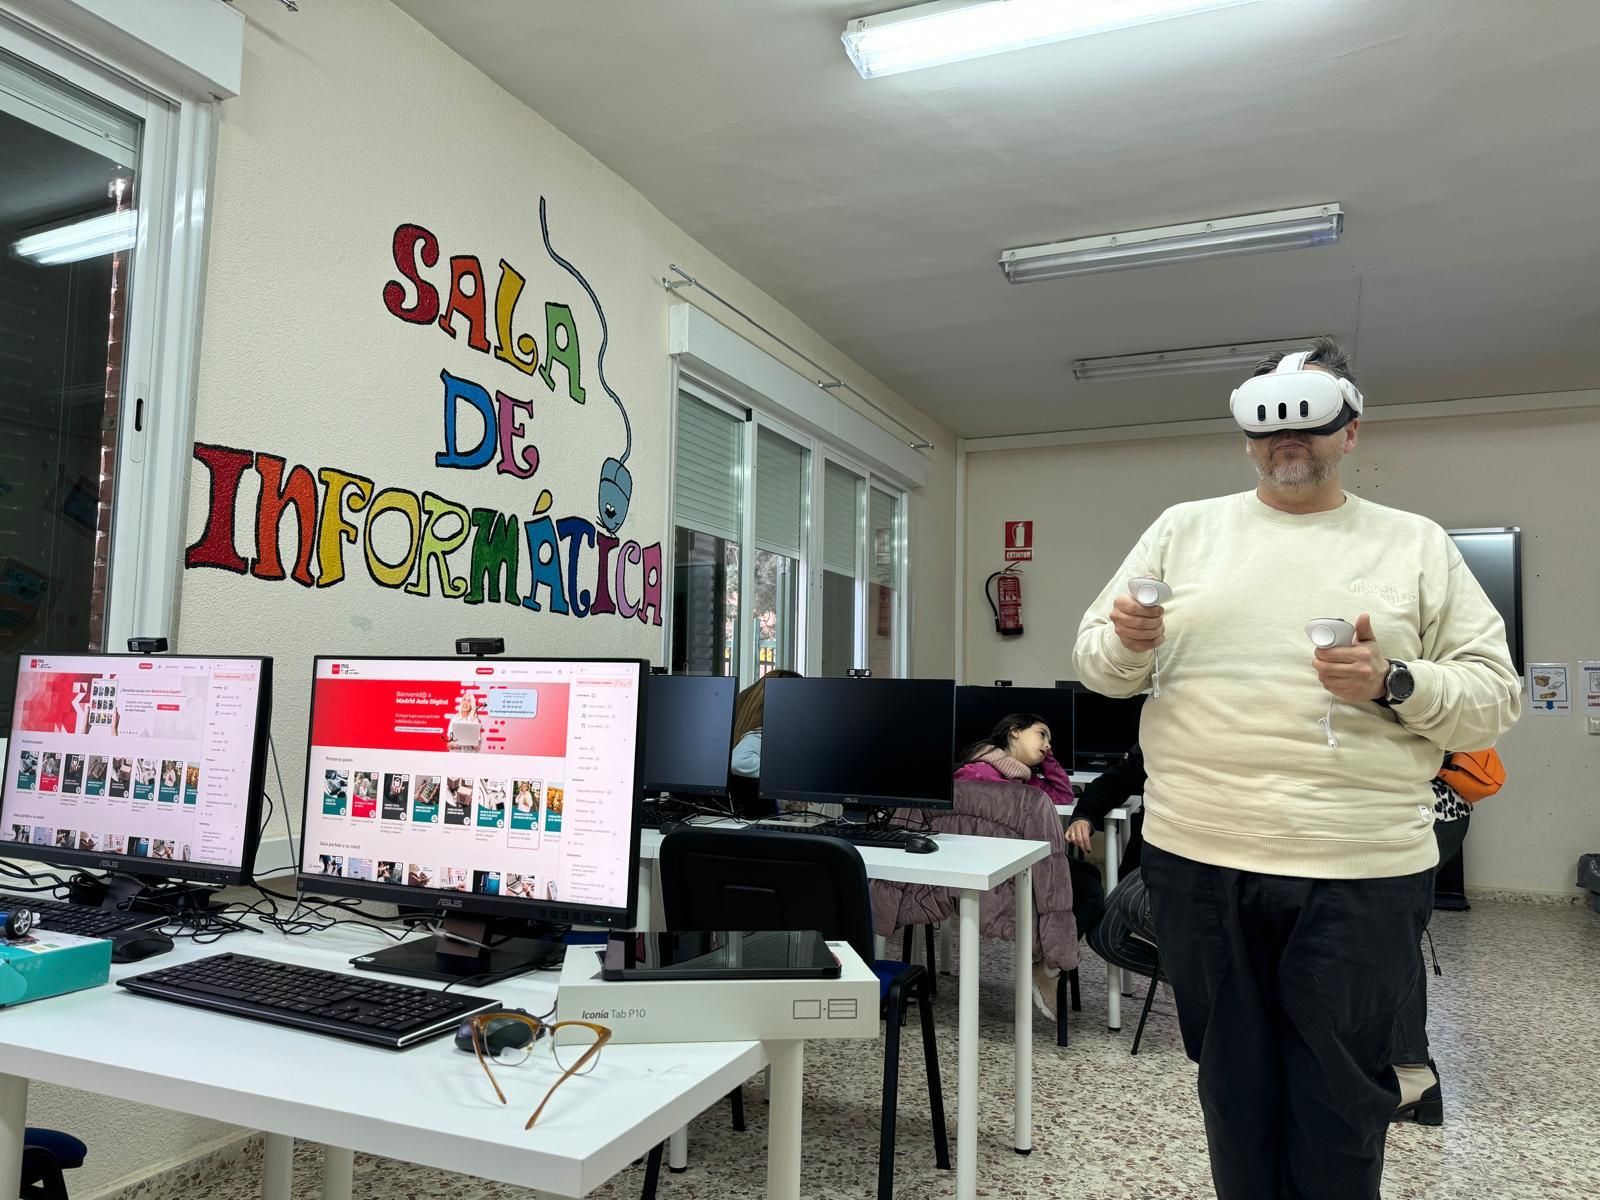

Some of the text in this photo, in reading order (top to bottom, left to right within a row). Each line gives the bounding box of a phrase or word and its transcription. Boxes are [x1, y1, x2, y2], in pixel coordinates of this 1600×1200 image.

[383, 223, 585, 404] SALA
[436, 369, 539, 479] DE
[429, 698, 449, 706] Digital
[99, 860, 119, 868] ASUS
[436, 898, 463, 908] ASUS
[582, 1008, 646, 1019] Iconia Tab P10
